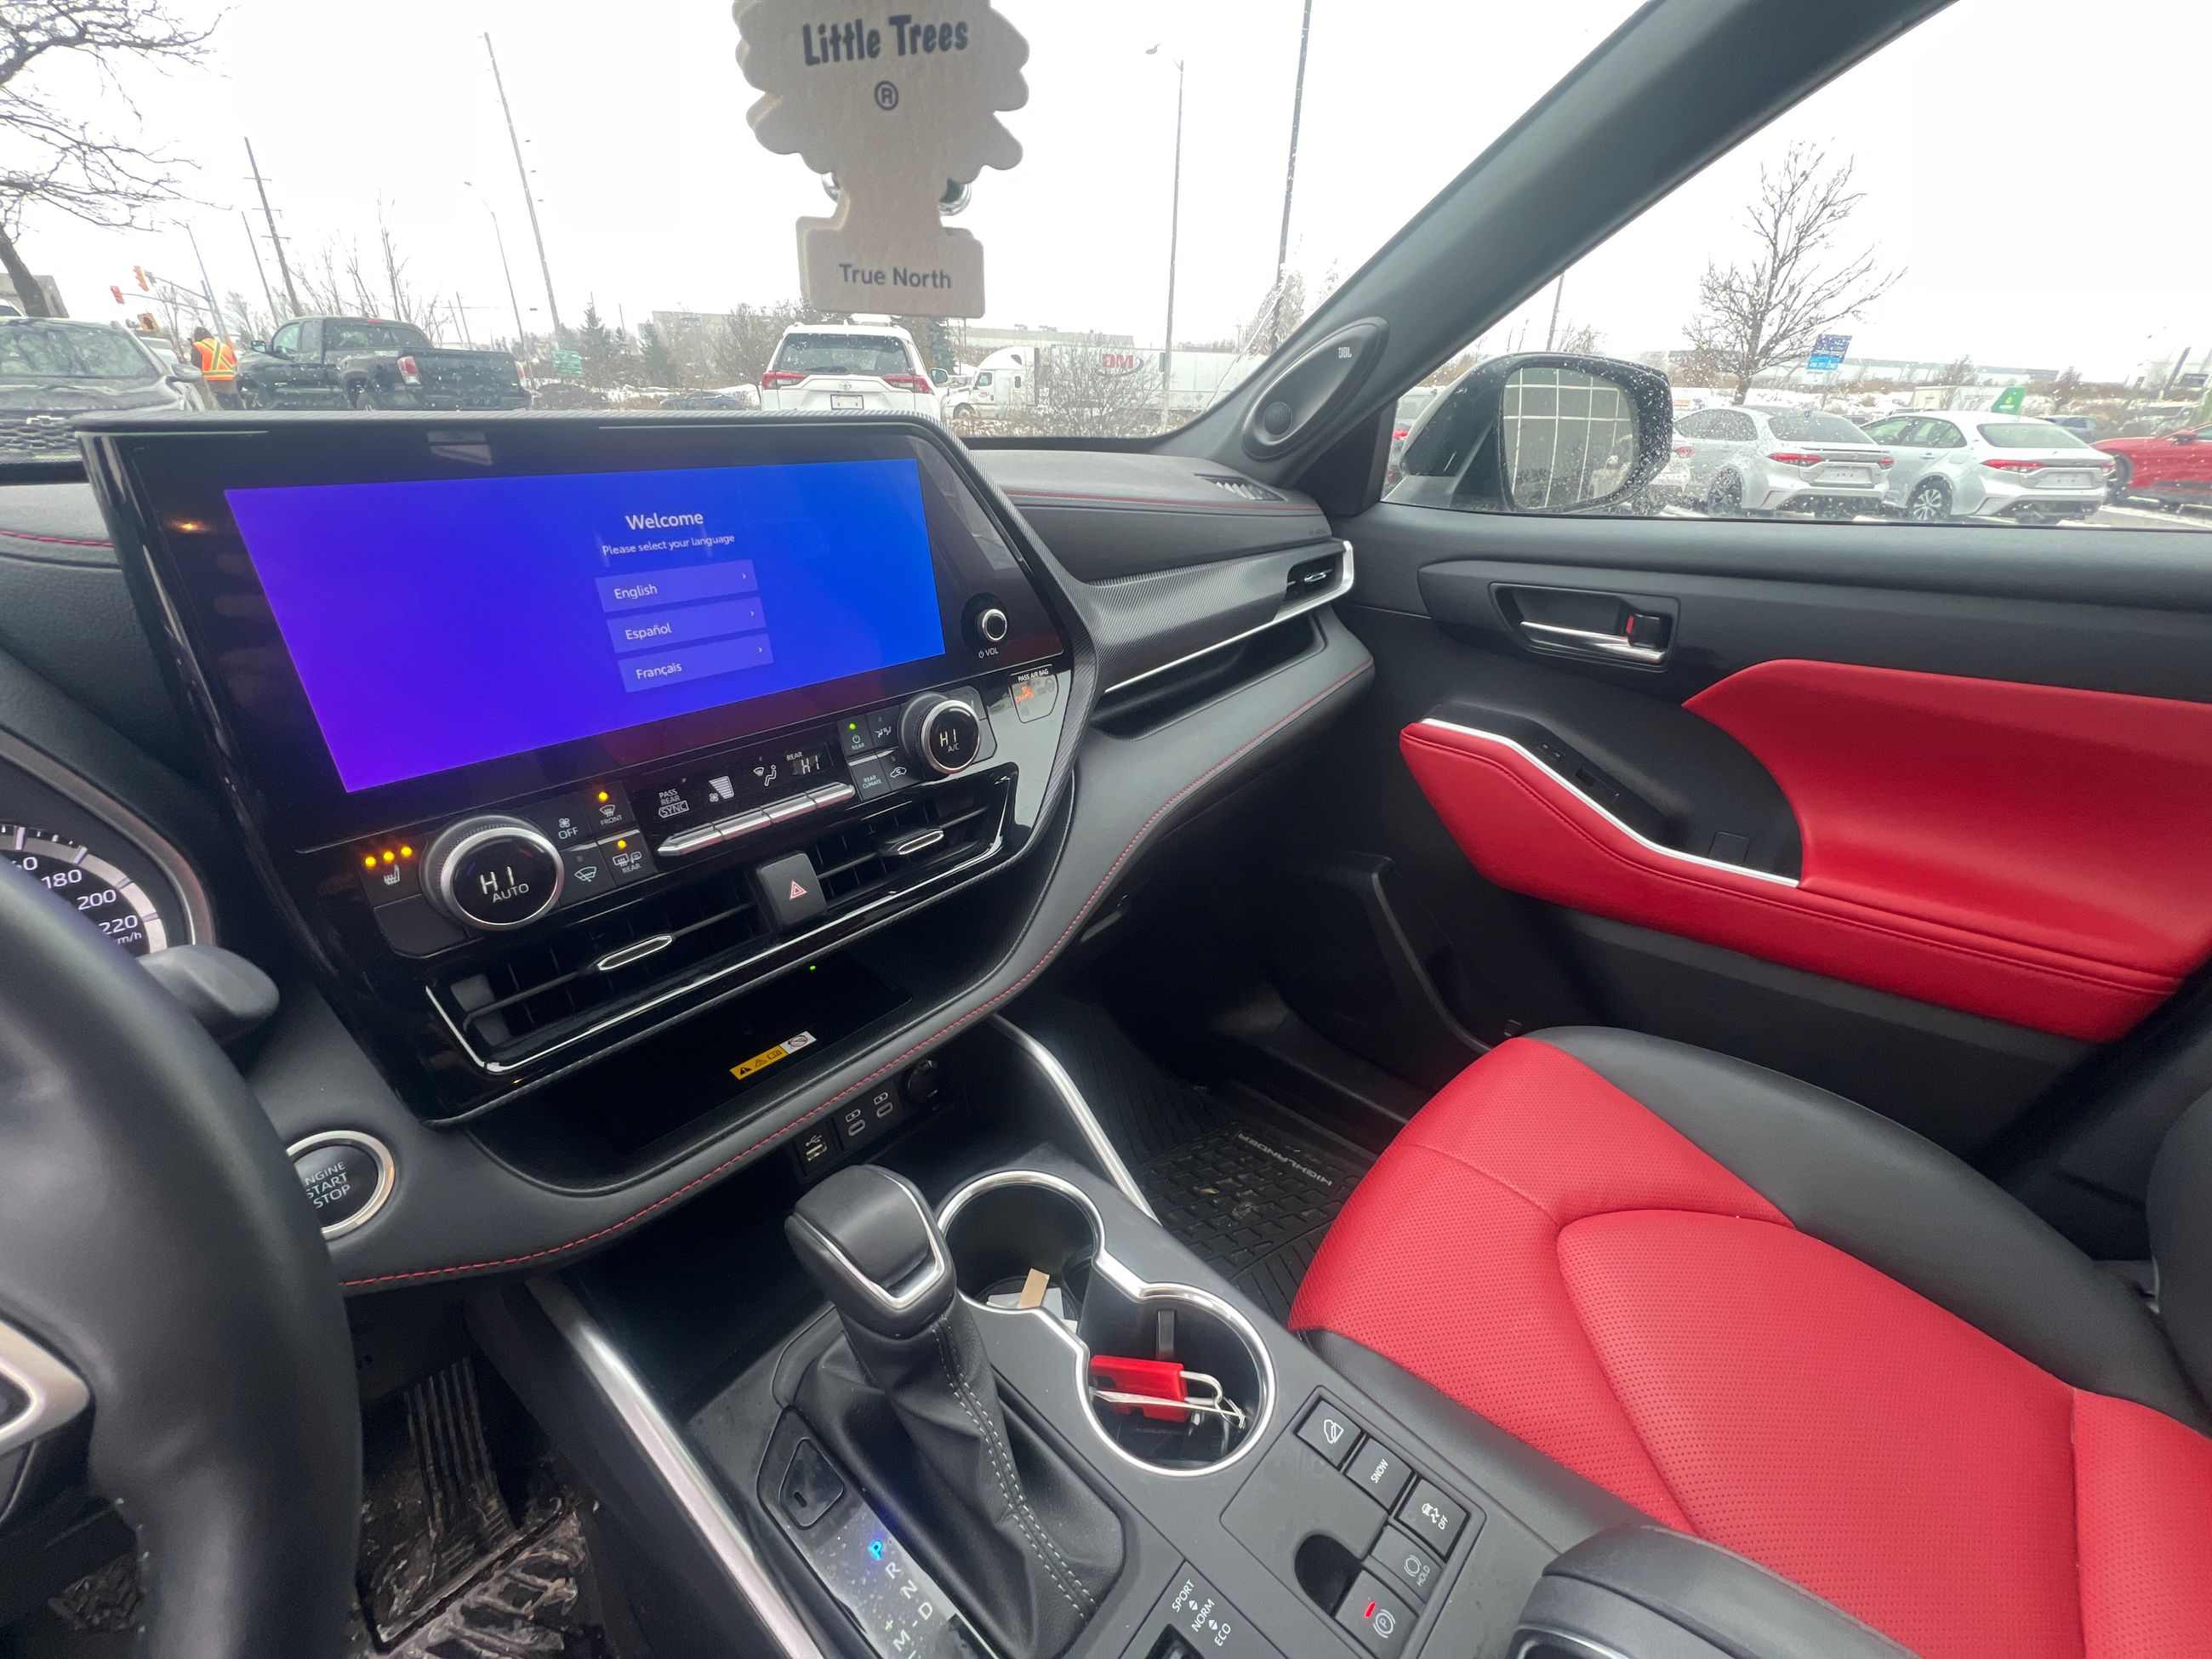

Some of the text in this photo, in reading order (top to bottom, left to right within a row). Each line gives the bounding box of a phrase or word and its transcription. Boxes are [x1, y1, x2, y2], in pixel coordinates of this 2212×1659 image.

[801, 14, 969, 66] Little Trees
[838, 263, 952, 289] True North
[624, 512, 704, 531] Welcome
[601, 534, 735, 556] Please select your language
[613, 584, 658, 600] English
[624, 623, 672, 640] Español
[984, 647, 1000, 657] VOL
[636, 662, 682, 680] Français
[1018, 673, 1029, 682] PASS
[1038, 668, 1049, 676] BAG
[786, 751, 804, 761] REAR
[947, 744, 960, 753] A/C
[658, 788, 678, 799] PASS
[660, 795, 681, 807] REAR
[660, 801, 687, 816] SYNC
[600, 814, 623, 826] FRONT
[558, 826, 579, 839] OFF
[622, 863, 641, 874] REAR
[41, 869, 83, 889] 180
[77, 889, 117, 910] 200
[493, 883, 529, 903] AUTO
[115, 931, 143, 944] m/h
[304, 1160, 346, 1187] NGINE
[306, 1172, 348, 1199] START
[312, 1183, 351, 1209] STOP
[1371, 1458, 1389, 1484] SNOW
[1438, 1514, 1449, 1531] OFF
[869, 1539, 883, 1561] P
[885, 1561, 902, 1579] R
[1416, 1565, 1431, 1588] HOLD
[900, 1578, 918, 1599] N
[1172, 1578, 1194, 1612] SPORT
[1191, 1598, 1215, 1633] NORM
[1214, 1622, 1231, 1647] ECO
